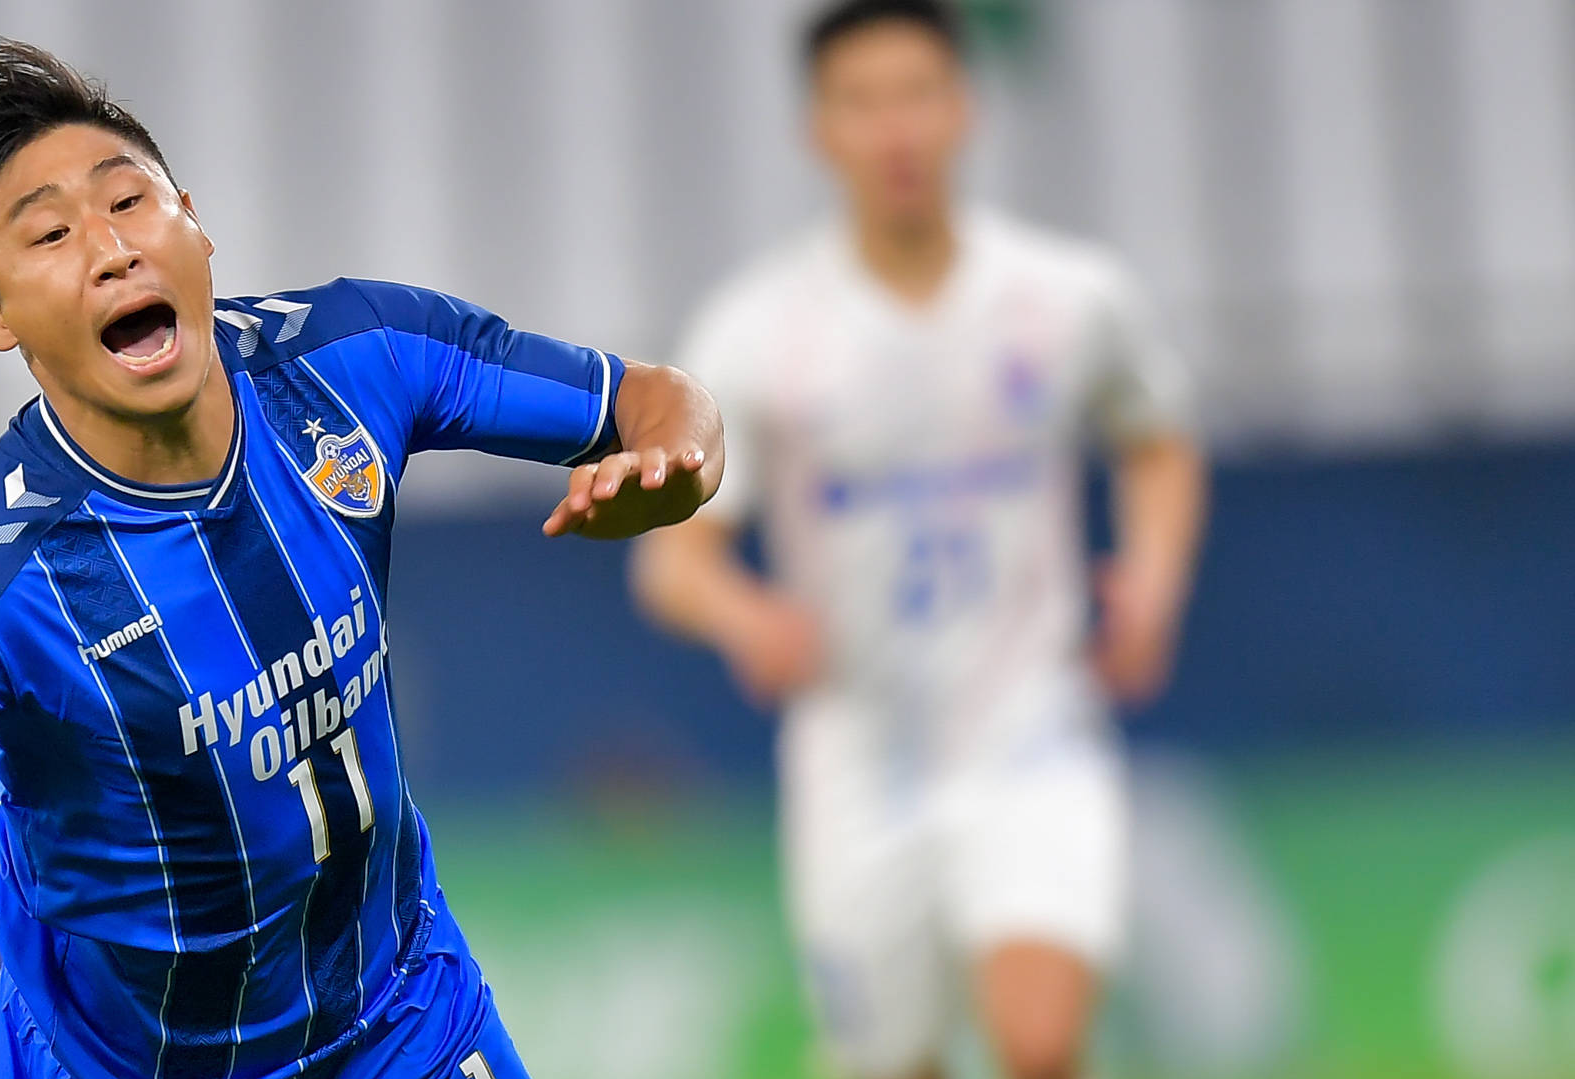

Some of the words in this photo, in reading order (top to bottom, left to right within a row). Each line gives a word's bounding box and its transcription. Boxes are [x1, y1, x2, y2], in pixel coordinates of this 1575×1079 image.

[322, 447, 371, 494] HYUNDAI
[77, 604, 163, 665] hummel
[178, 584, 366, 756] Hyundai
[287, 727, 373, 865] 11
